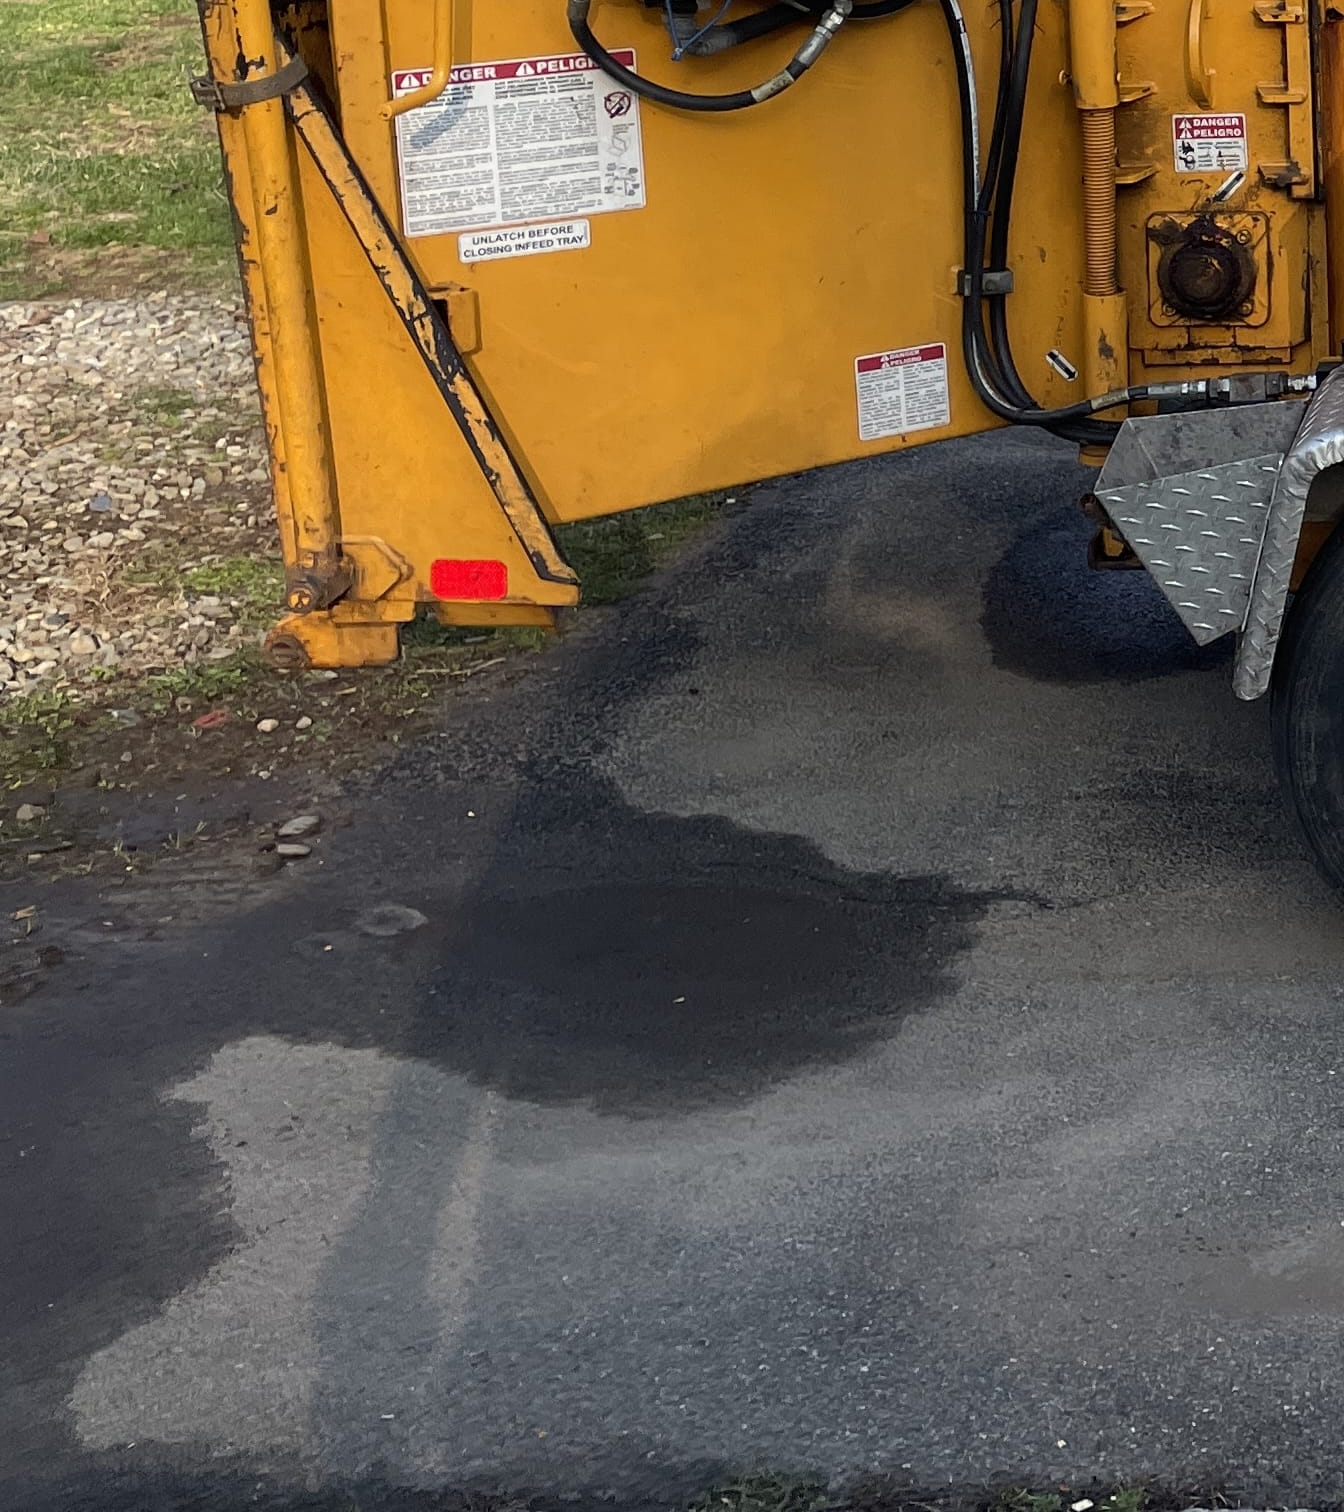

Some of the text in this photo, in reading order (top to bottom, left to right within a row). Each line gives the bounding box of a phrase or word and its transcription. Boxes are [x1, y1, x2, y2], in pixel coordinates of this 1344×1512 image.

[421, 67, 497, 85] DNGER
[1192, 118, 1240, 127] DANGER
[1193, 128, 1242, 138] PELIGRO
[472, 225, 574, 246] UNLATCH BEFORE
[463, 234, 584, 259] CLOSING INFEED TRAY
[890, 356, 922, 366] PELIGRO
